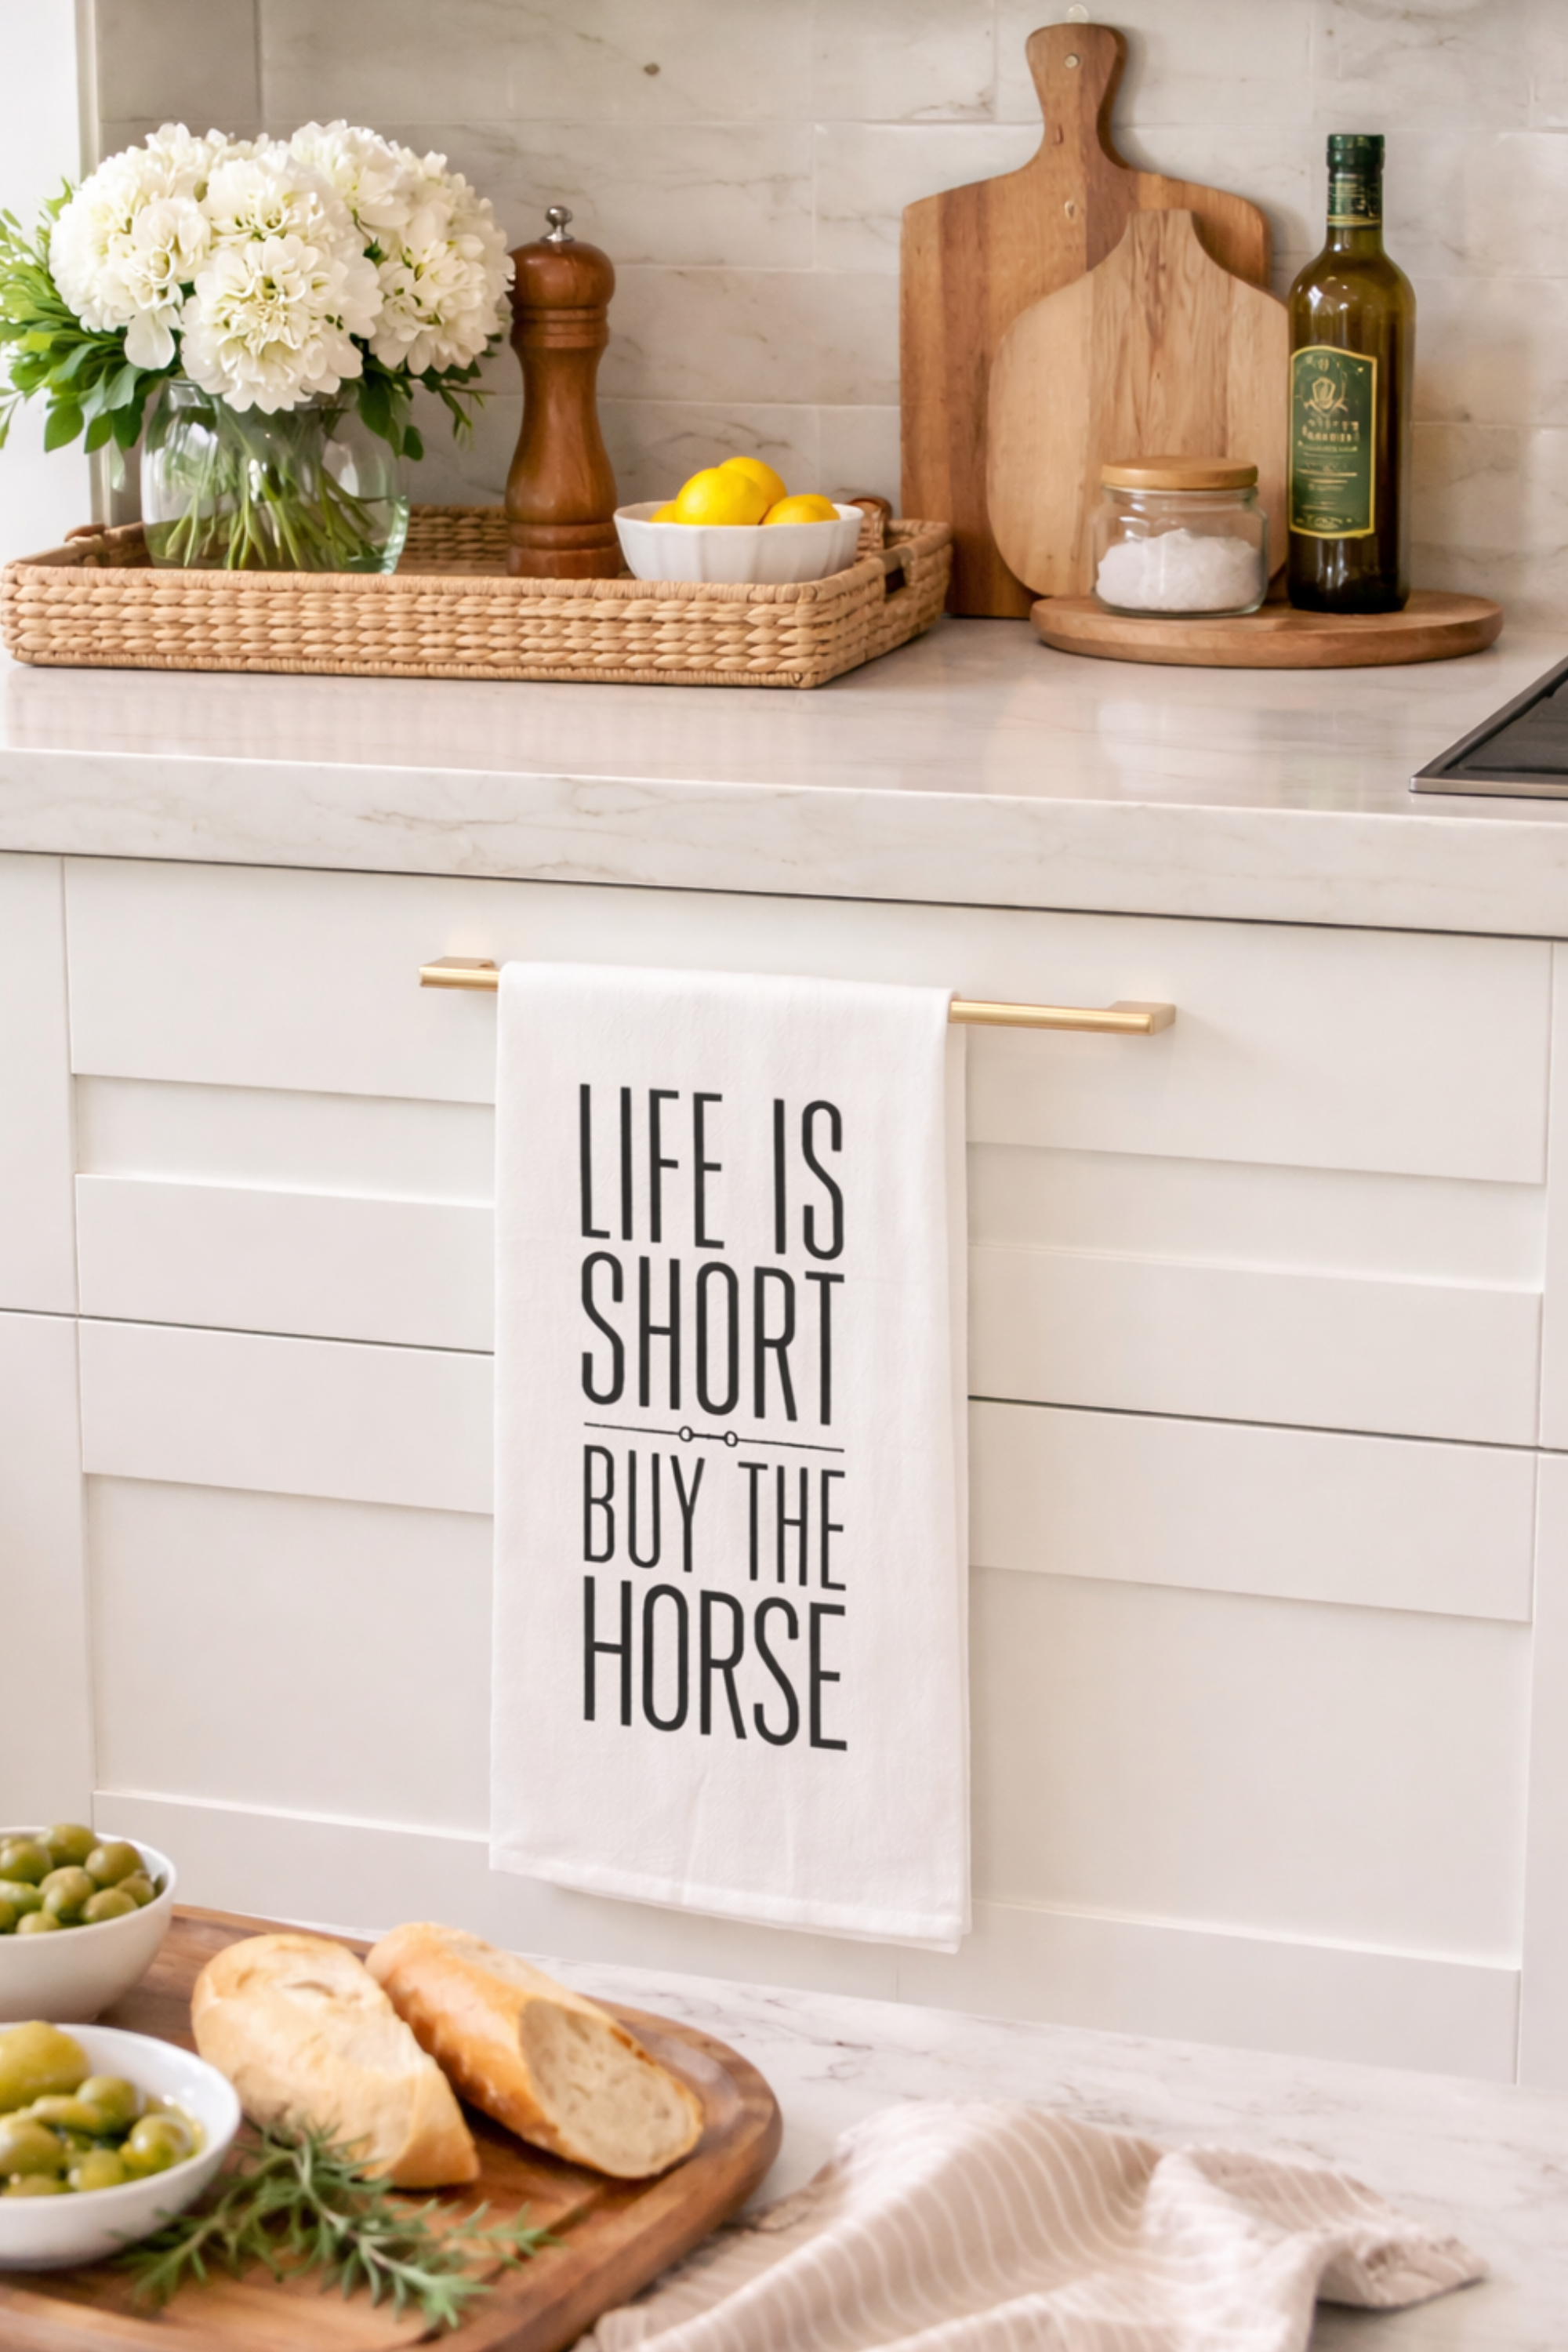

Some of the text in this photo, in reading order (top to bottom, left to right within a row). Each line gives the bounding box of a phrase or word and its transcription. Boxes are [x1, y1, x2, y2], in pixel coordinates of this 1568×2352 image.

[579, 1083, 844, 1261] LIFE IS
[581, 1251, 845, 1426] SHORT
[583, 1444, 846, 1591] BUY THE
[584, 1575, 848, 1751] HORSE
